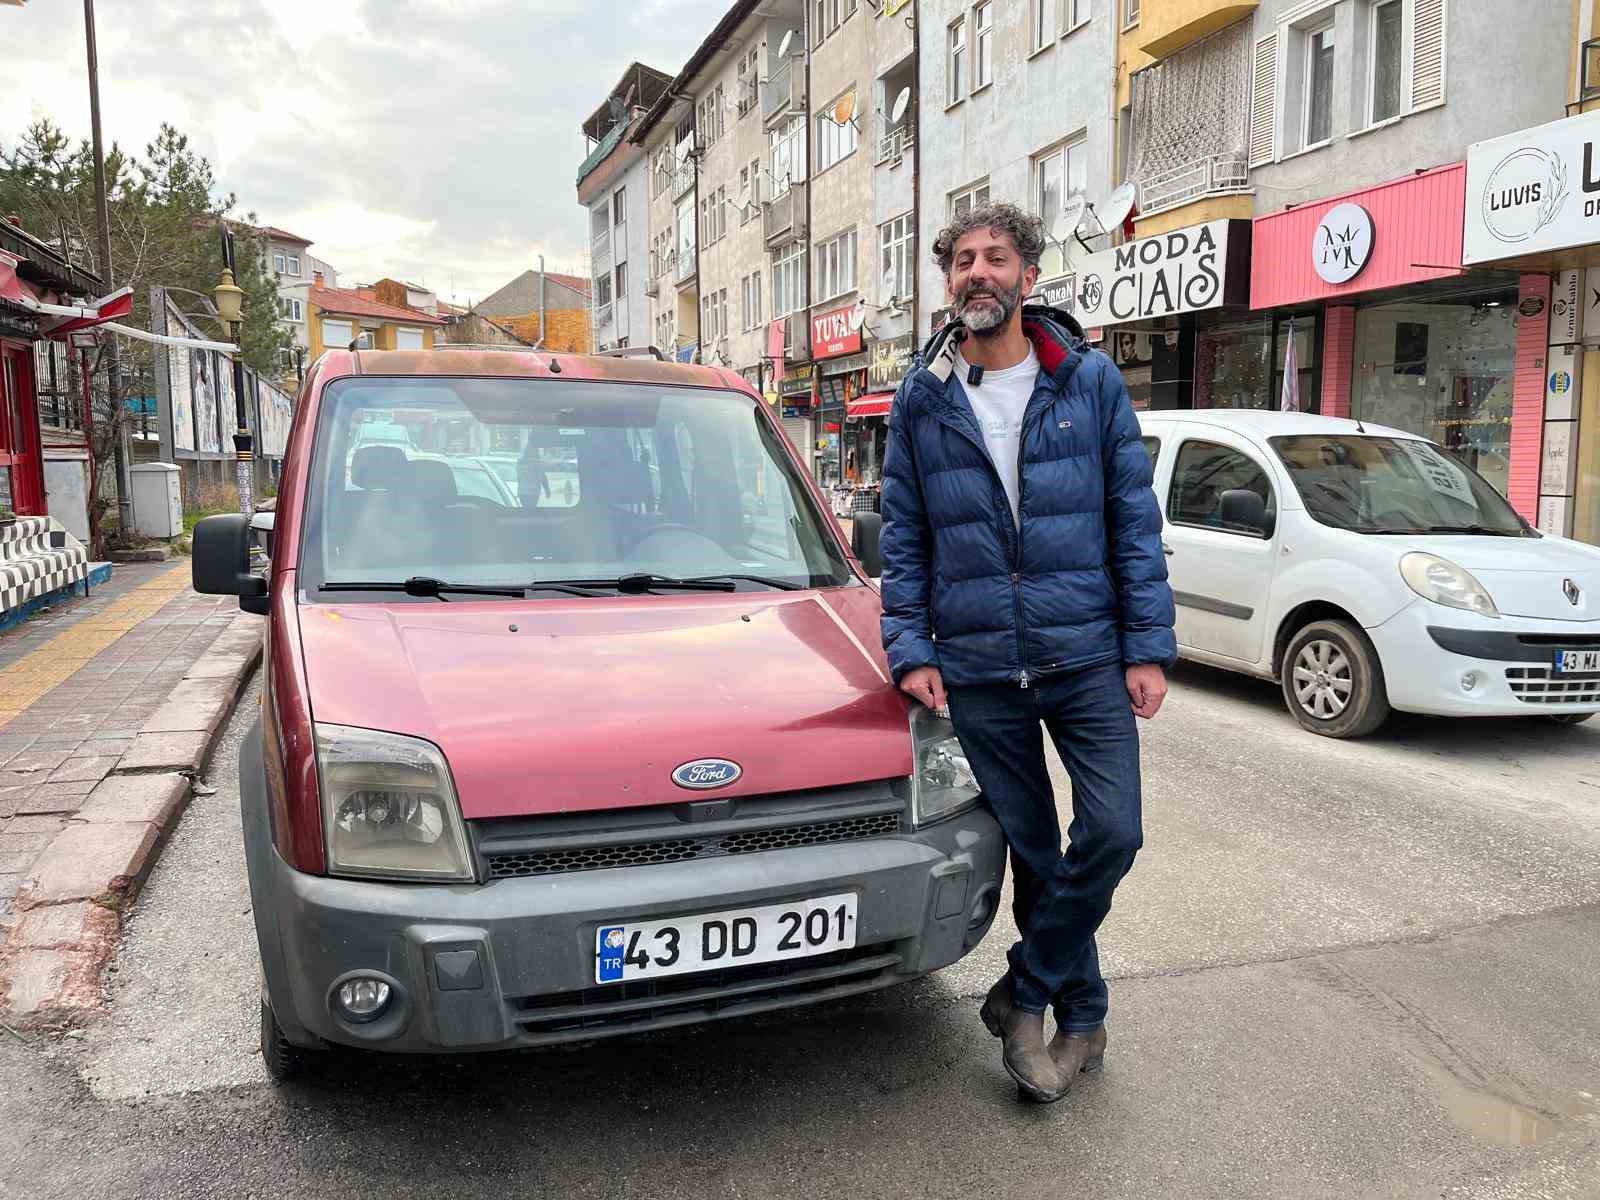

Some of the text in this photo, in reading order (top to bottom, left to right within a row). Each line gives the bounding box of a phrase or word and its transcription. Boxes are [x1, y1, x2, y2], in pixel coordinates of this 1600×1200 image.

[1114, 225, 1216, 272] MODA
[689, 763, 727, 783] Ford
[623, 903, 847, 969] 43 DD 201
[603, 957, 621, 970] TR
